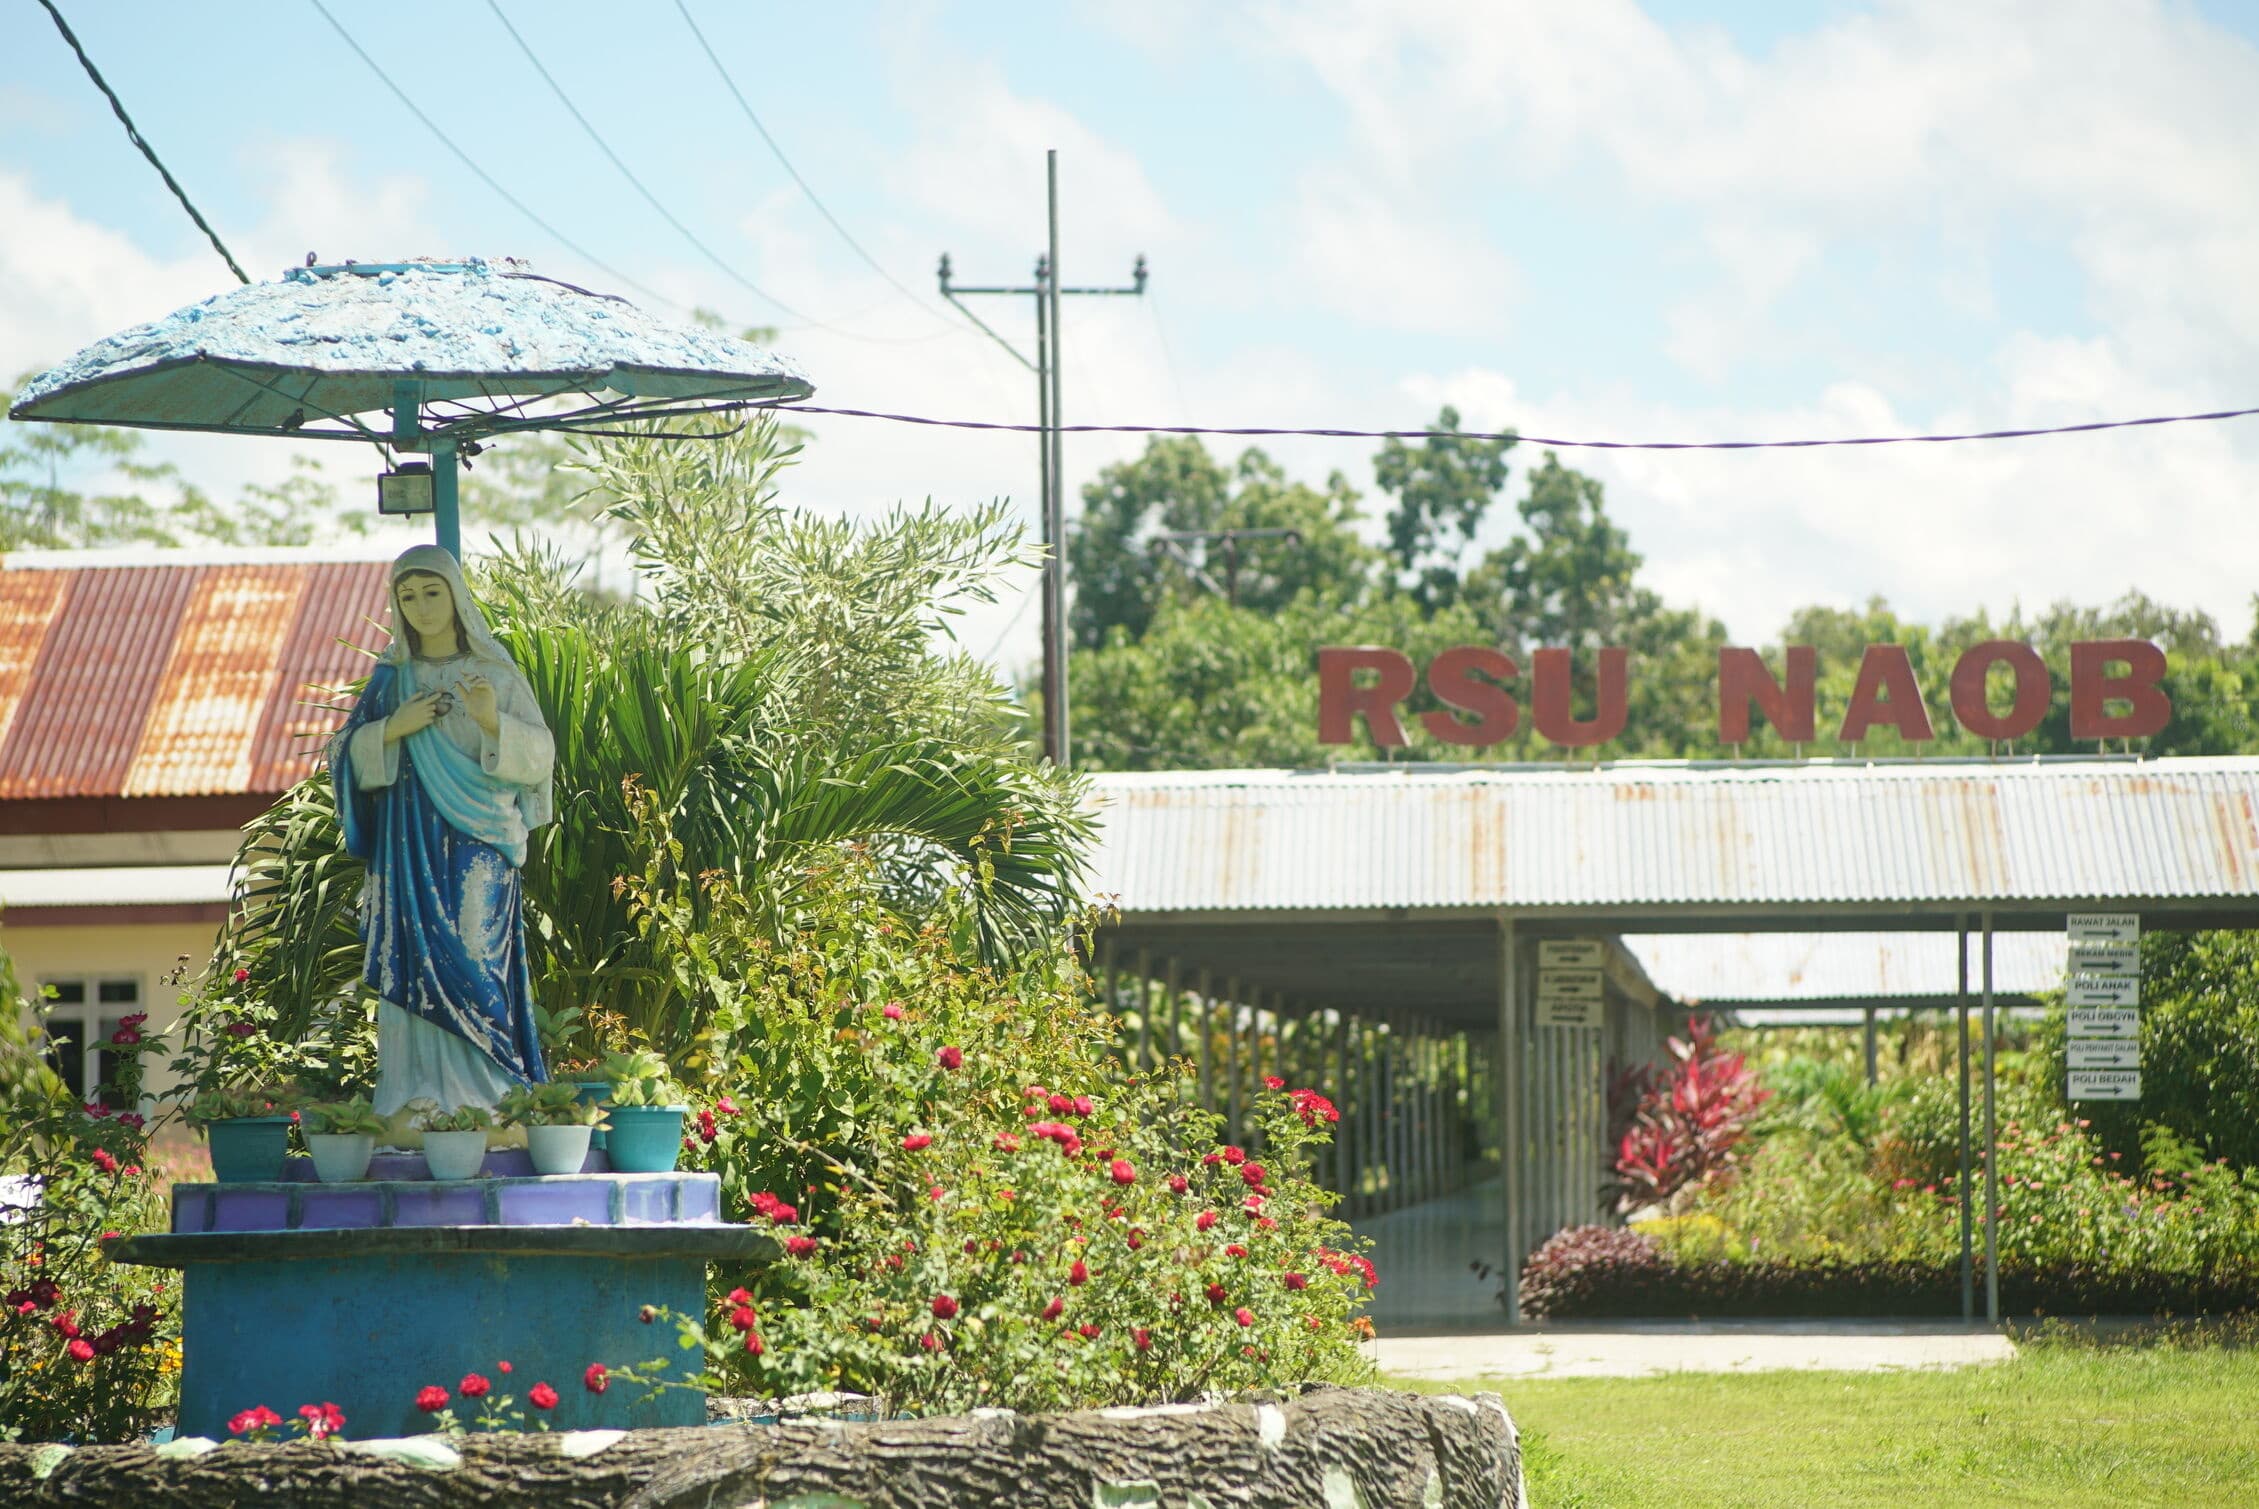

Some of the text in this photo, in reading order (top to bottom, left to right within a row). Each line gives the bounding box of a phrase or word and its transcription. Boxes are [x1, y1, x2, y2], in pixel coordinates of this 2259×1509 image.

[1317, 639, 2172, 748] RSU NAOB
[2071, 917, 2135, 926] RAWAT JALAN
[2074, 980, 2131, 990] POLI ANAK
[2071, 1011, 2095, 1020] POLI
[2072, 1074, 2136, 1083] POLI BEDAH
